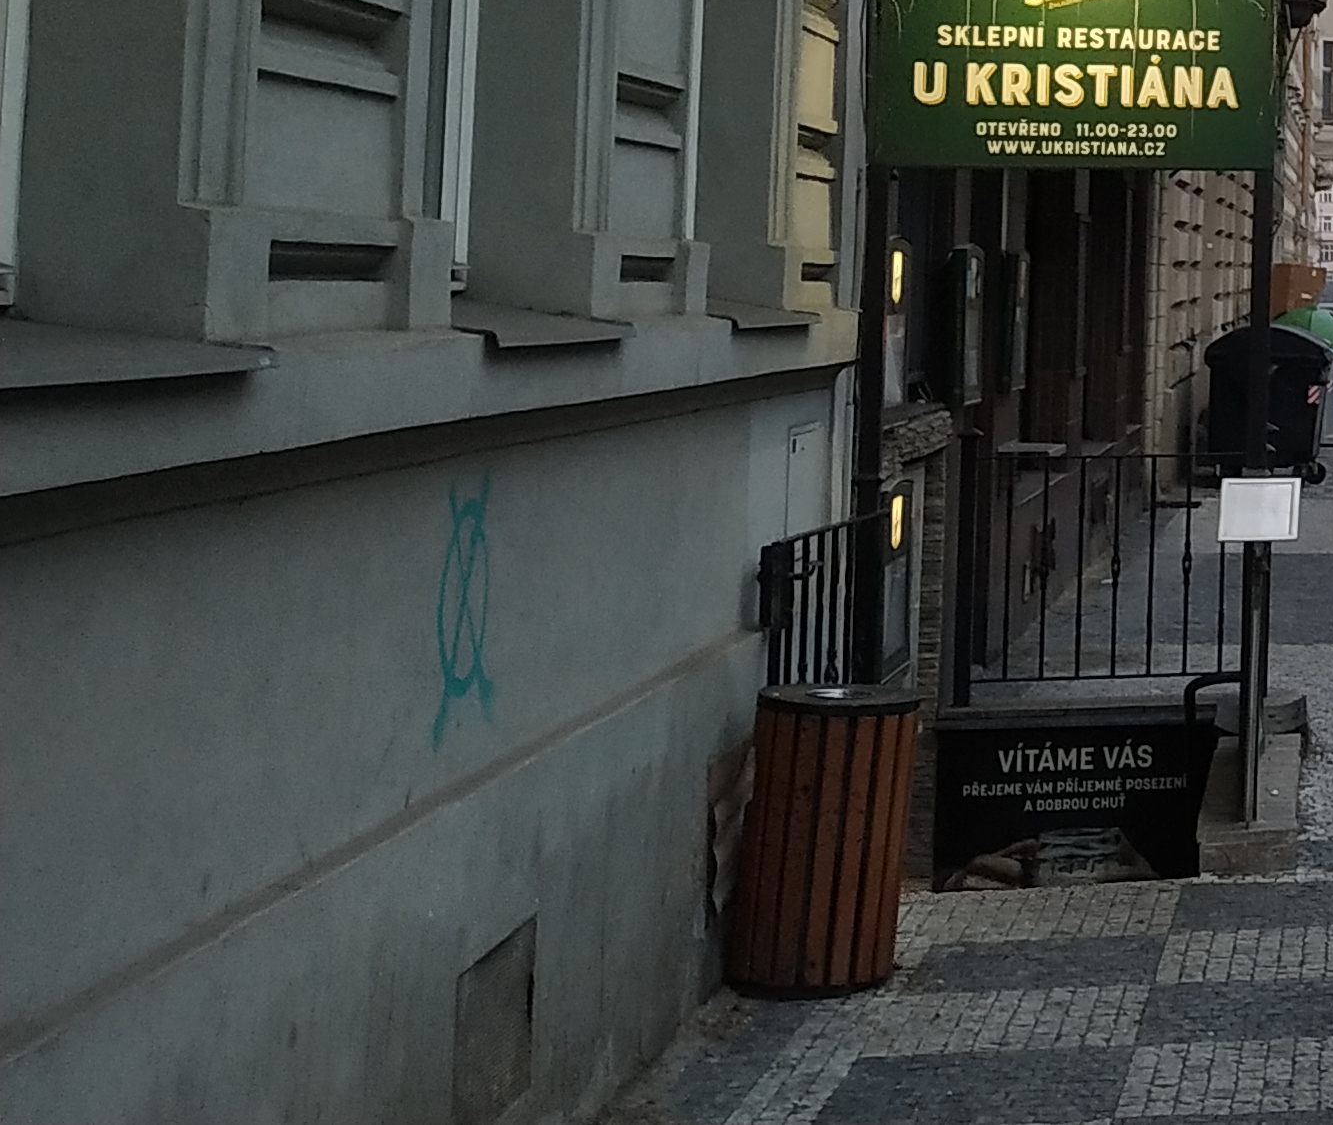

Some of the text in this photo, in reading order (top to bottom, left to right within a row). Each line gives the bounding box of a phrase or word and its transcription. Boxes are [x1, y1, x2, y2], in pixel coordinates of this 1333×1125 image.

[937, 22, 1221, 51] SKLEPNÍ RESTAURACE
[913, 54, 1240, 109] U KRISTIÁNA
[976, 118, 1178, 138] OTEVŘENO 11.00-23.00
[986, 140, 1167, 156] WWW.UKRISTIANA.CZ
[998, 739, 1153, 773] VÍTÁME VÁS
[962, 774, 1187, 797] PŘEJEME VÁM PŘÍJEMNÉ POSEZENÍ
[1024, 793, 1126, 812] A DOBROU CHUŤ
